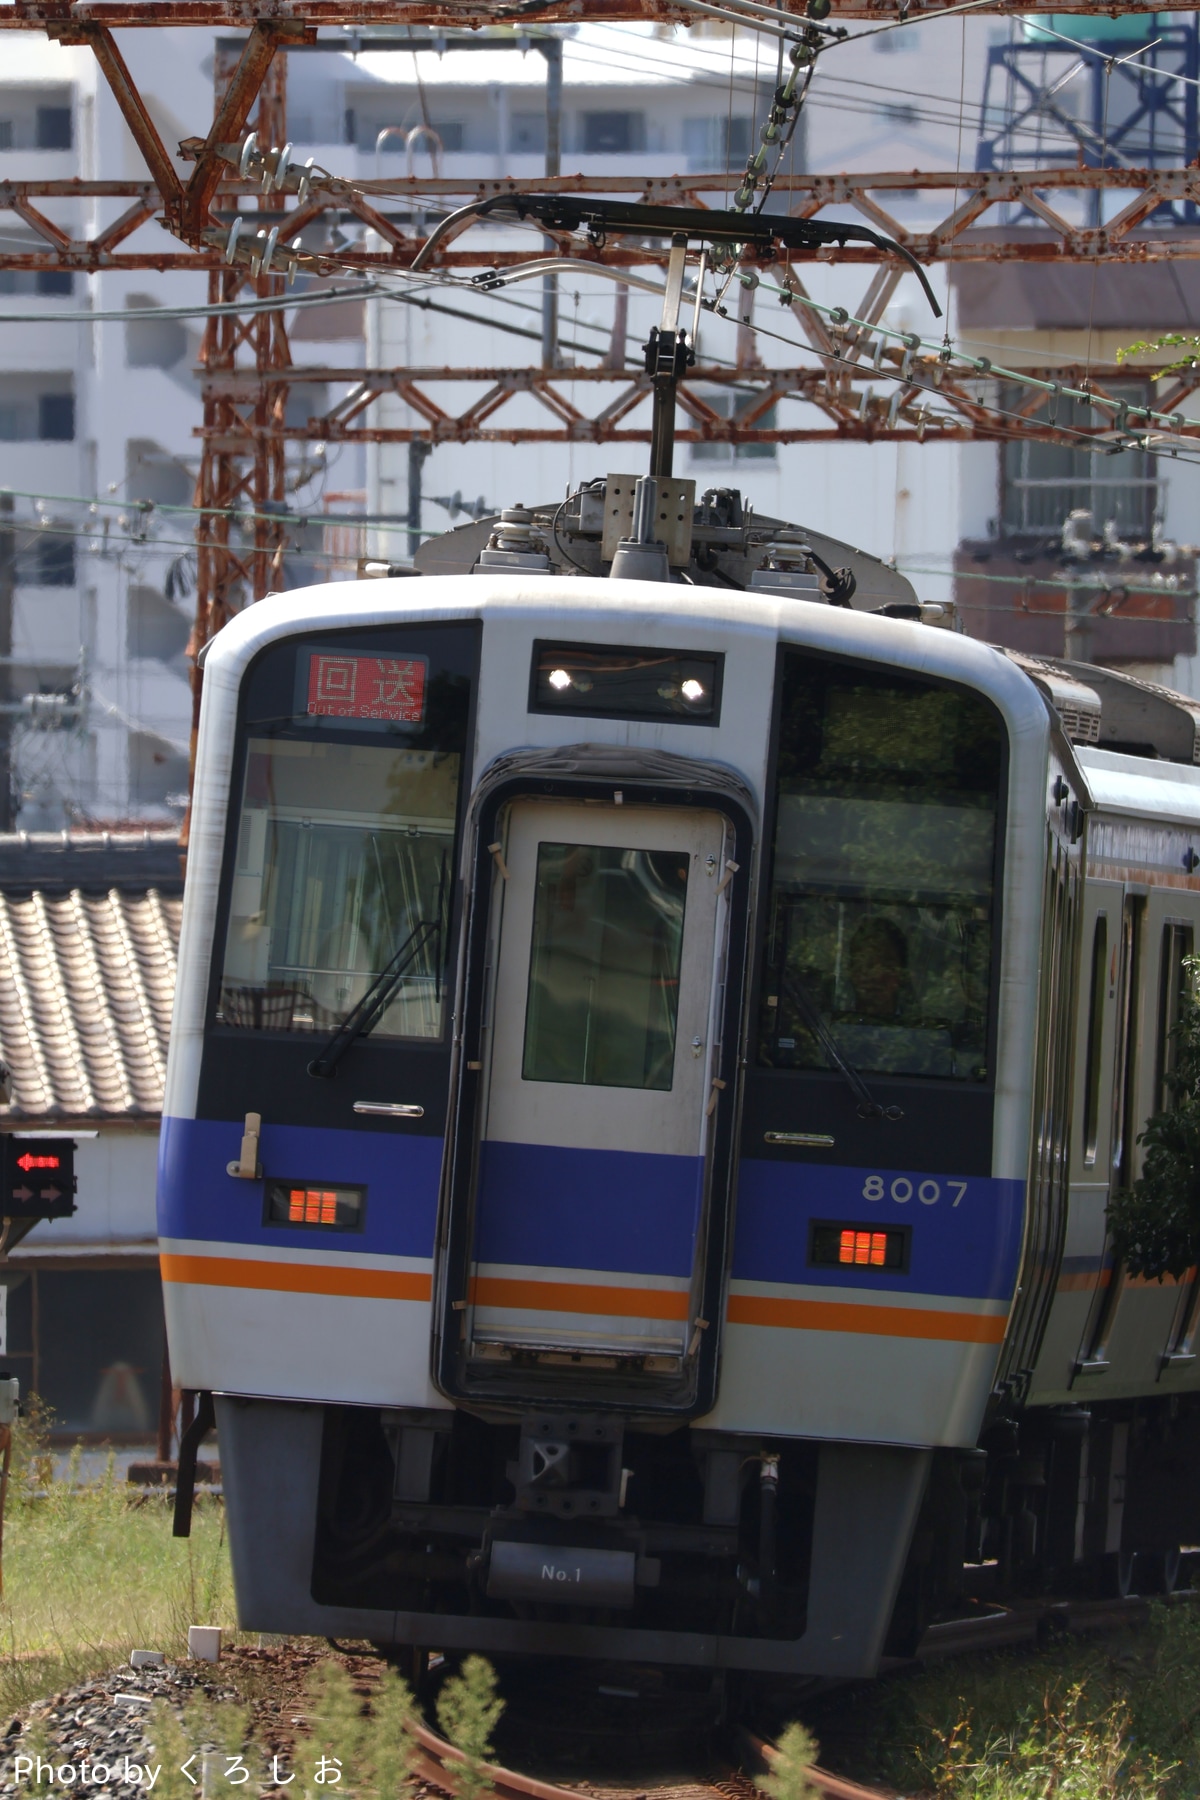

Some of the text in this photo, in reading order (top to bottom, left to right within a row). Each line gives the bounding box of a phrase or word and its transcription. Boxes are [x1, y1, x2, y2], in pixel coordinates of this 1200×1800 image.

[317, 657, 415, 707] 回送
[307, 702, 420, 722] Out of Service
[862, 1175, 968, 1208] 8007
[541, 1564, 581, 1583] No.1
